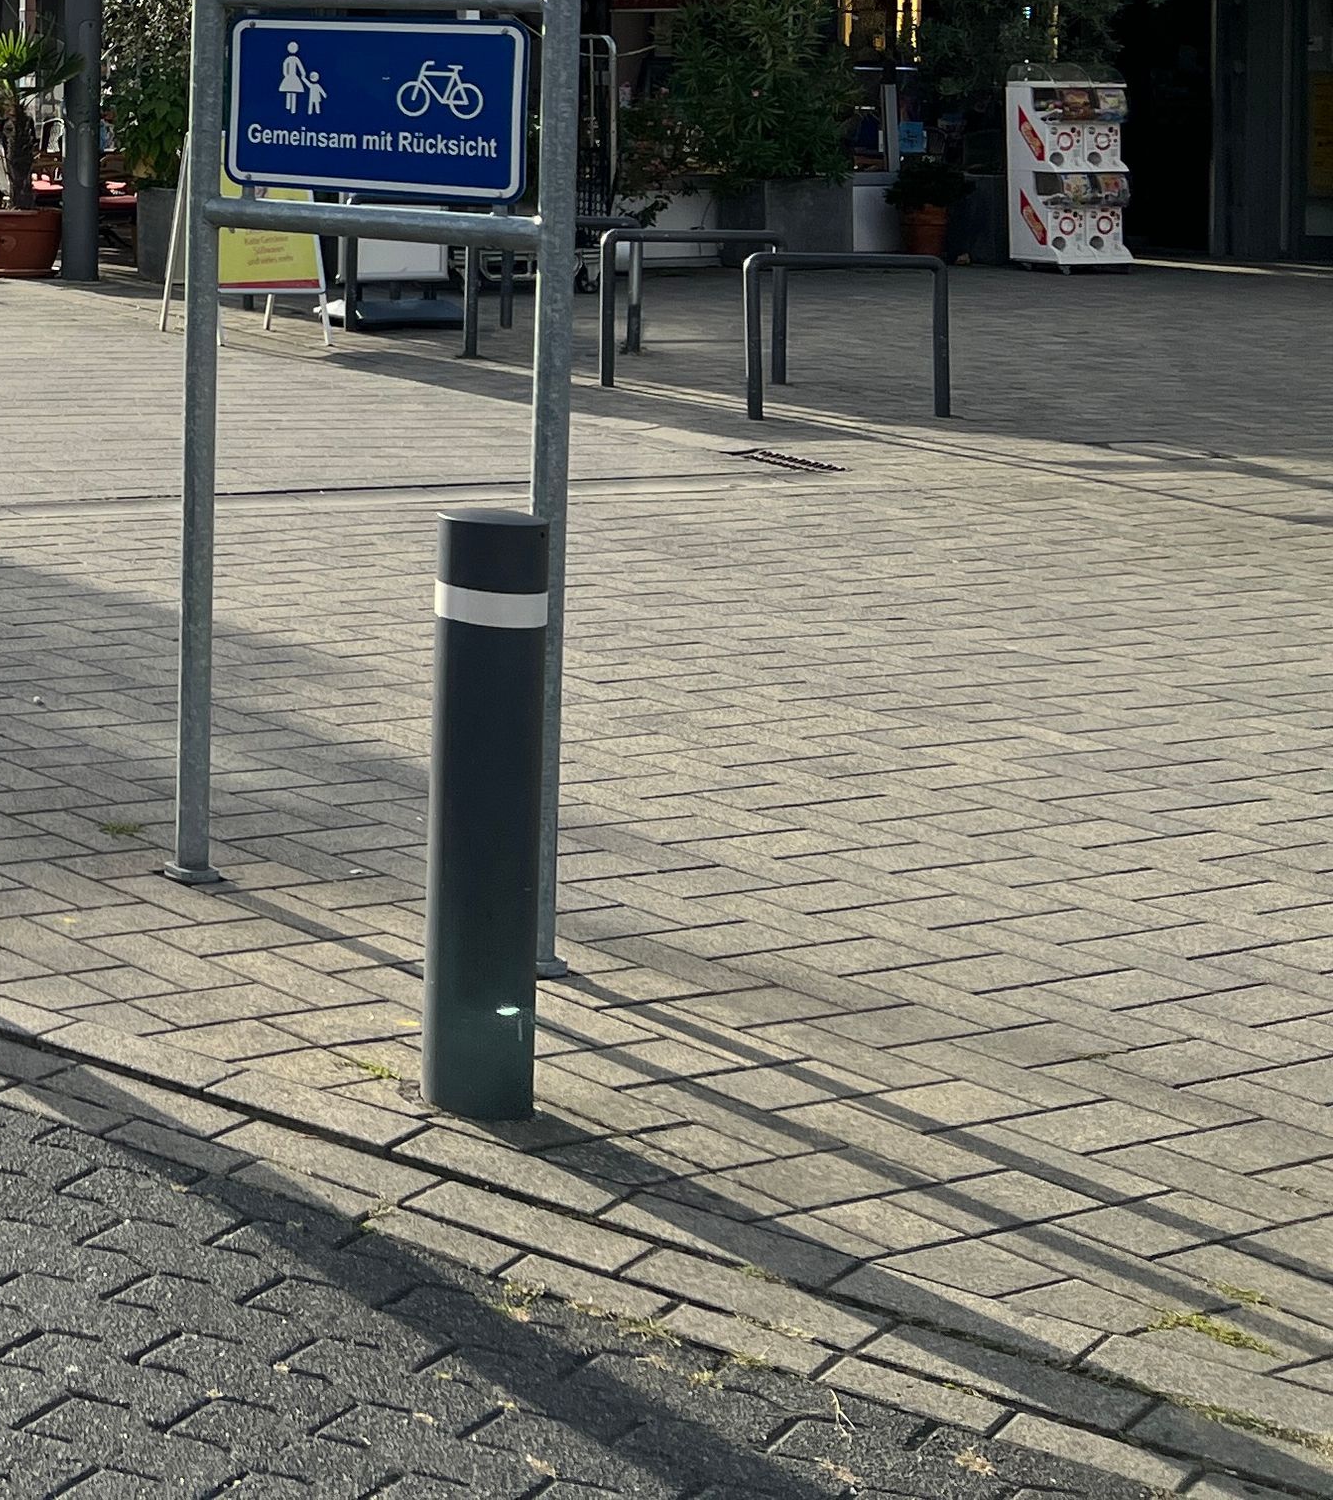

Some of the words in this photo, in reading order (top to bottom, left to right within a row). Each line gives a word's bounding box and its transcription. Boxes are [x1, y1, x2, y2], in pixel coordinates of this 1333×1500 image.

[247, 123, 357, 149] Gemeinsam
[362, 130, 393, 152] mit
[398, 131, 497, 158] Rücksicht
